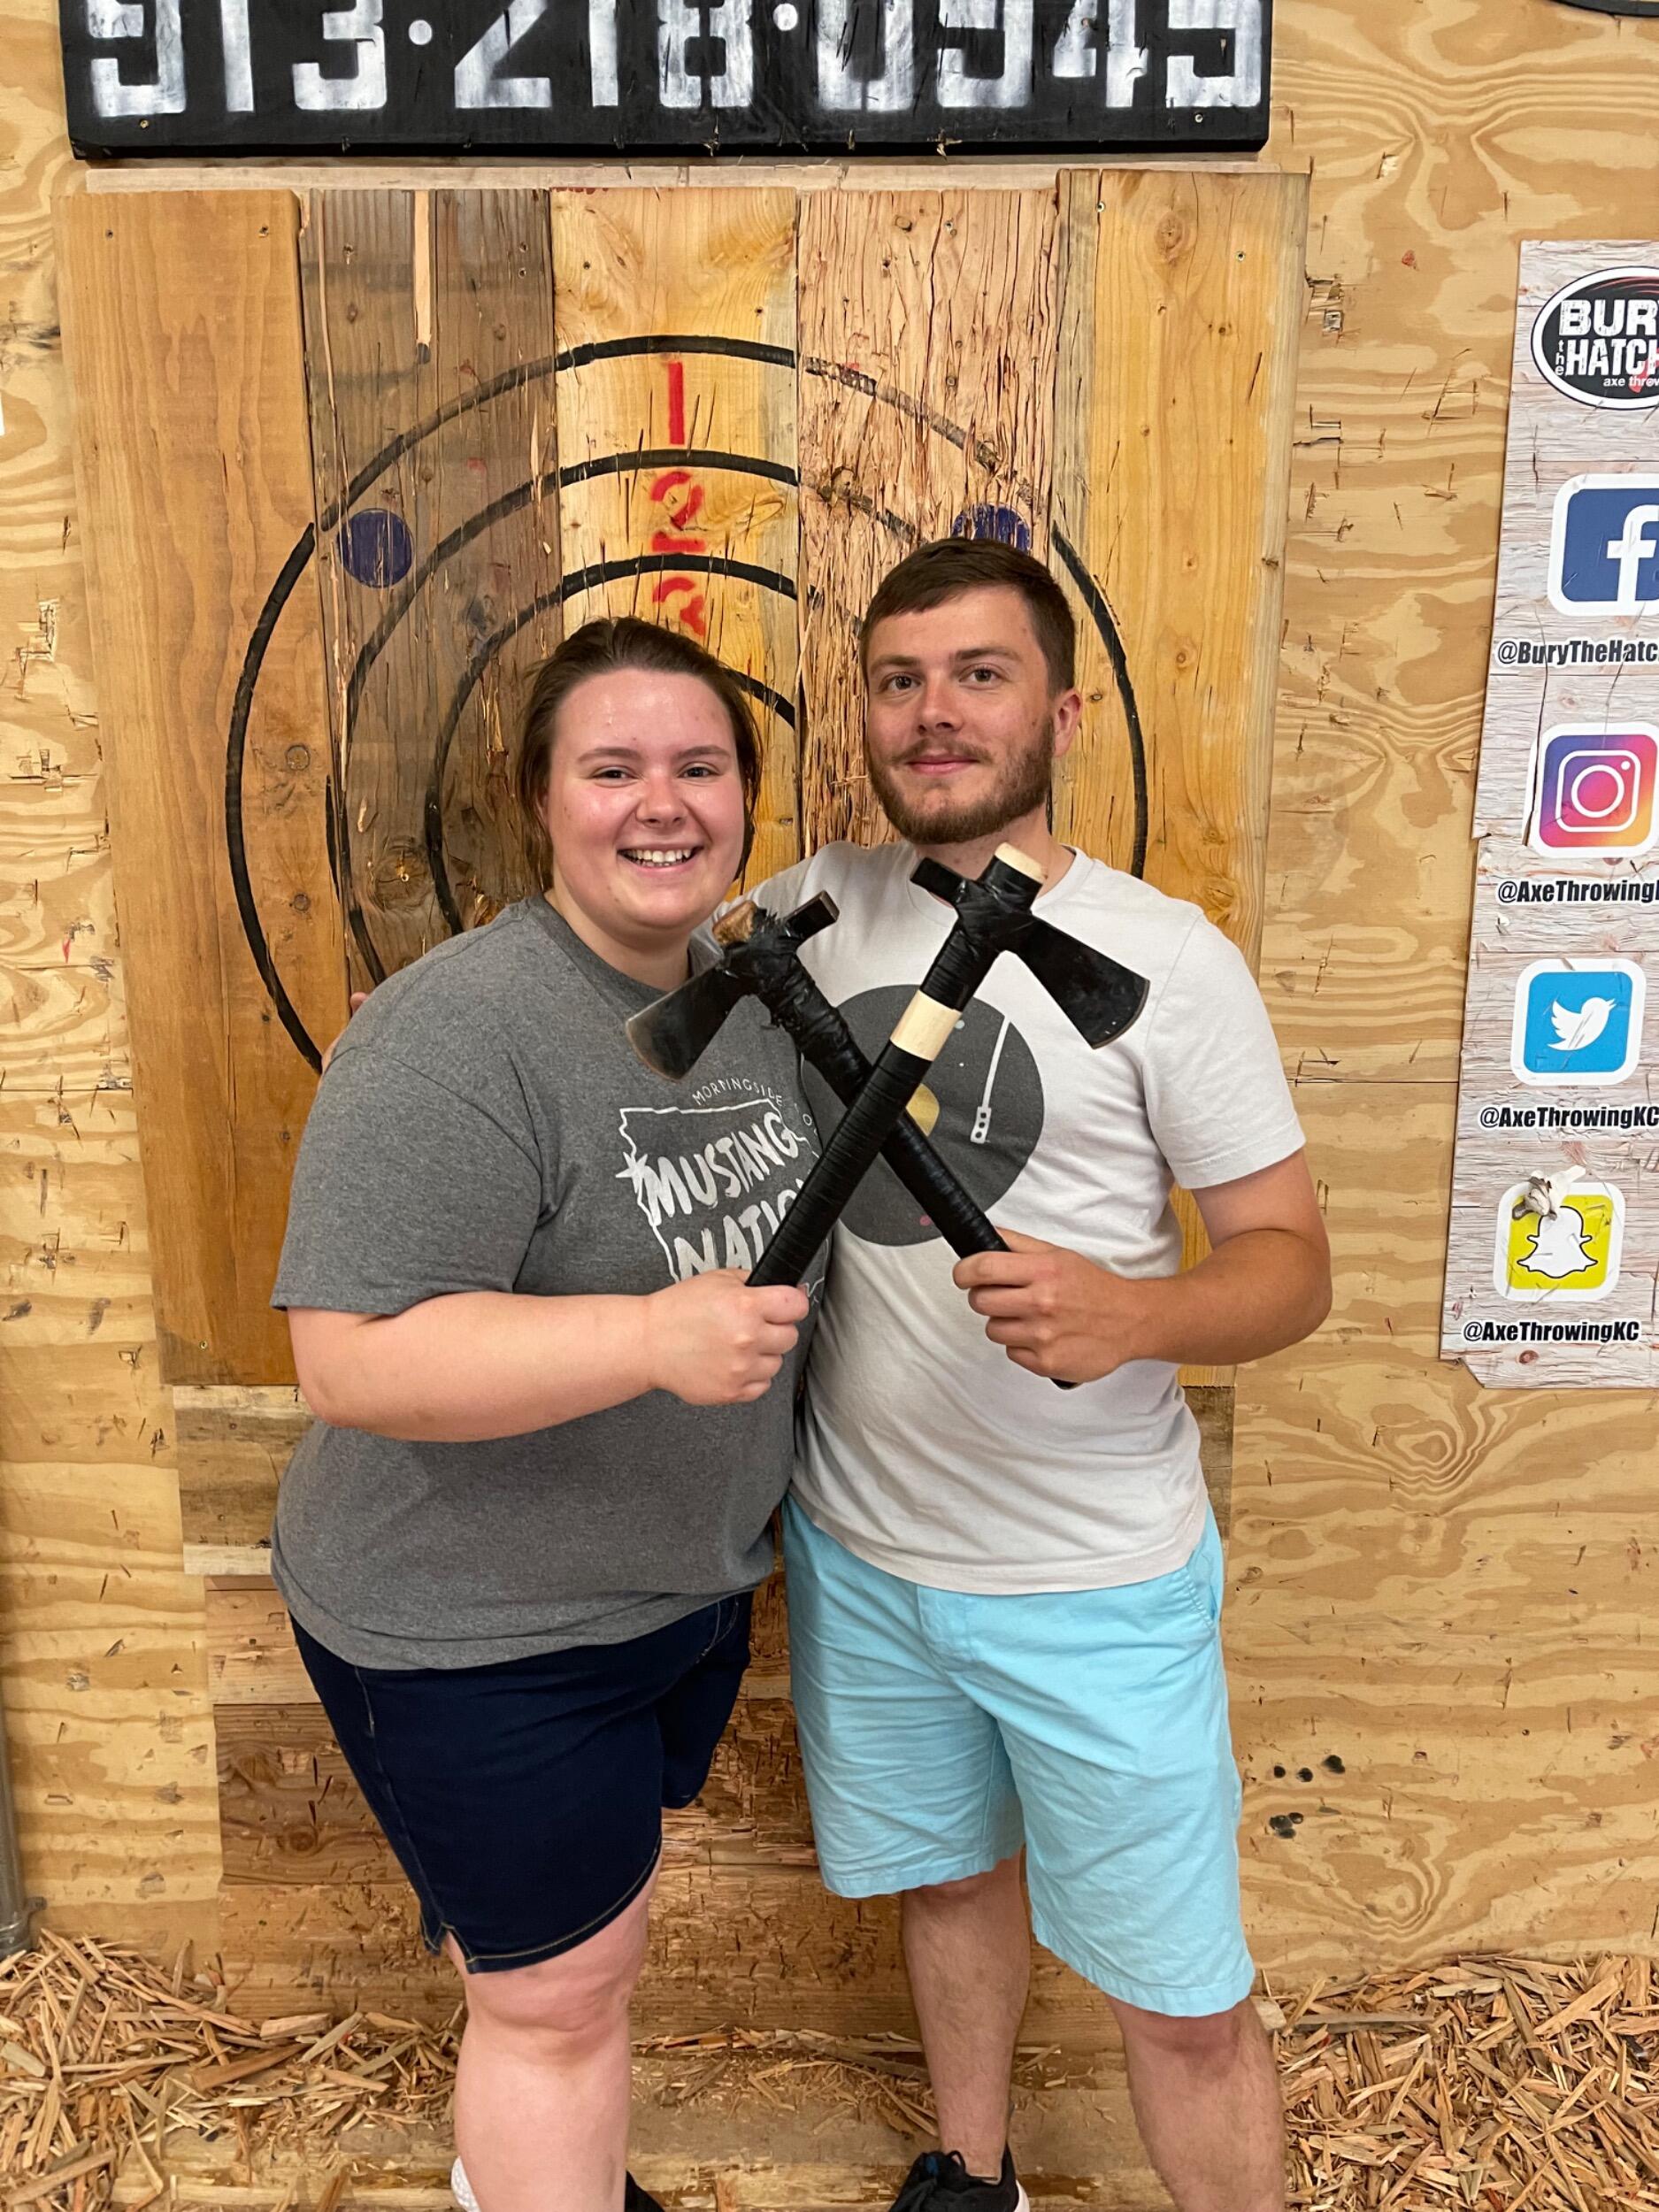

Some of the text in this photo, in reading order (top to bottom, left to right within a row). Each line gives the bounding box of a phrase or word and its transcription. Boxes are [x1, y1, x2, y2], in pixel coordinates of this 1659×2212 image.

[1559, 299, 1659, 337] BUR
[1555, 339, 1565, 376] the
[1603, 377, 1625, 387] axe
[650, 471, 706, 552] 2
[1498, 641, 1659, 664] @BuryTheHatc
[1480, 1106, 1659, 1129] @AxeThrowingKC
[641, 1112, 799, 1226] MUSTANG
[673, 1179, 803, 1283] NATI
[1463, 1321, 1640, 1343] @AxeThrowingKC
